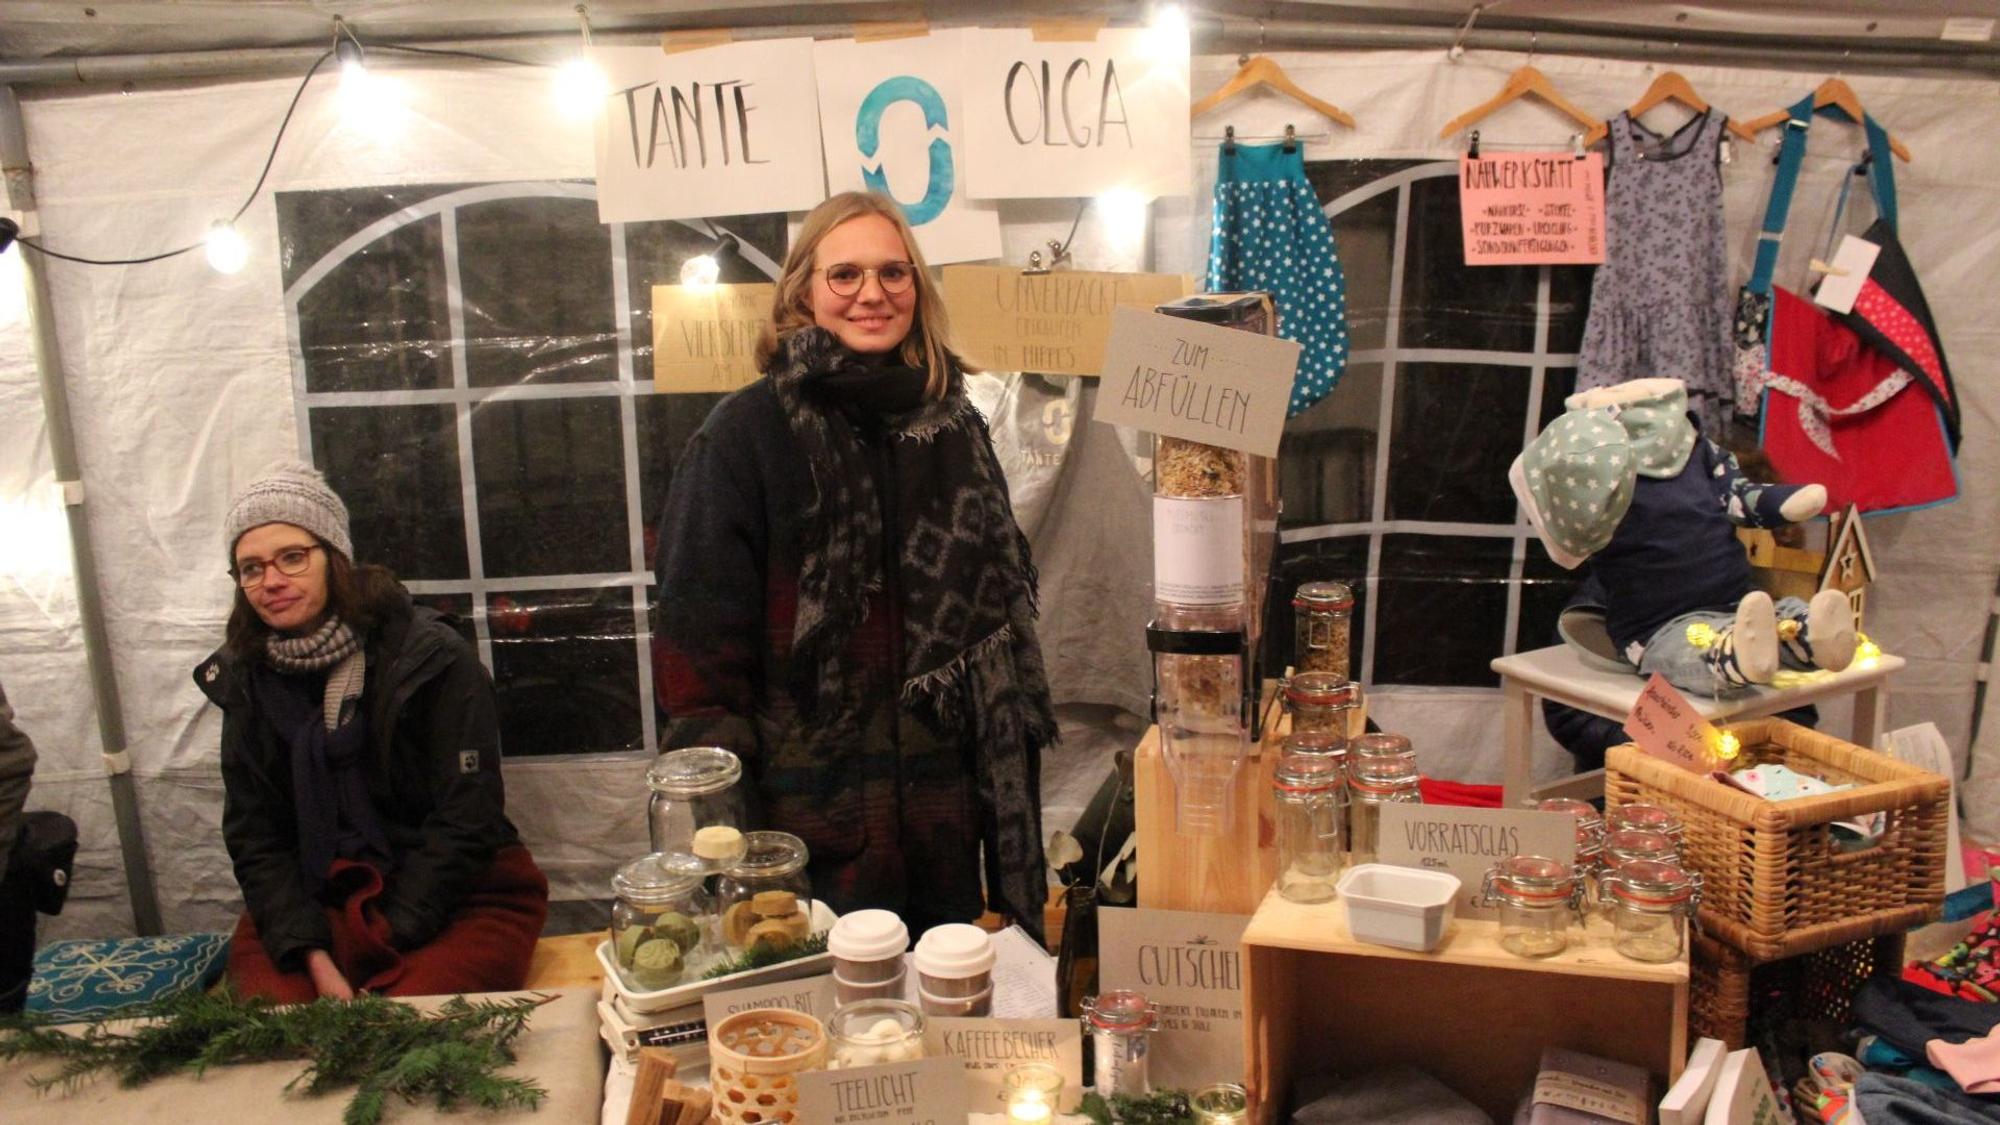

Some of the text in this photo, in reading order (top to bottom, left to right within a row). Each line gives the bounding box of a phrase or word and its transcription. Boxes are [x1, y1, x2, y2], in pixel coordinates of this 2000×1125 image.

[614, 80, 771, 169] TANTE
[1004, 57, 1134, 149] OLGA
[1171, 338, 1209, 371] ZUM
[1121, 365, 1251, 434] ABFÜLLEN
[1138, 944, 1241, 990] GUTSCHEI
[943, 1030, 1060, 1060] KAFFEEBECHER
[830, 1071, 918, 1113] TEELICHT
